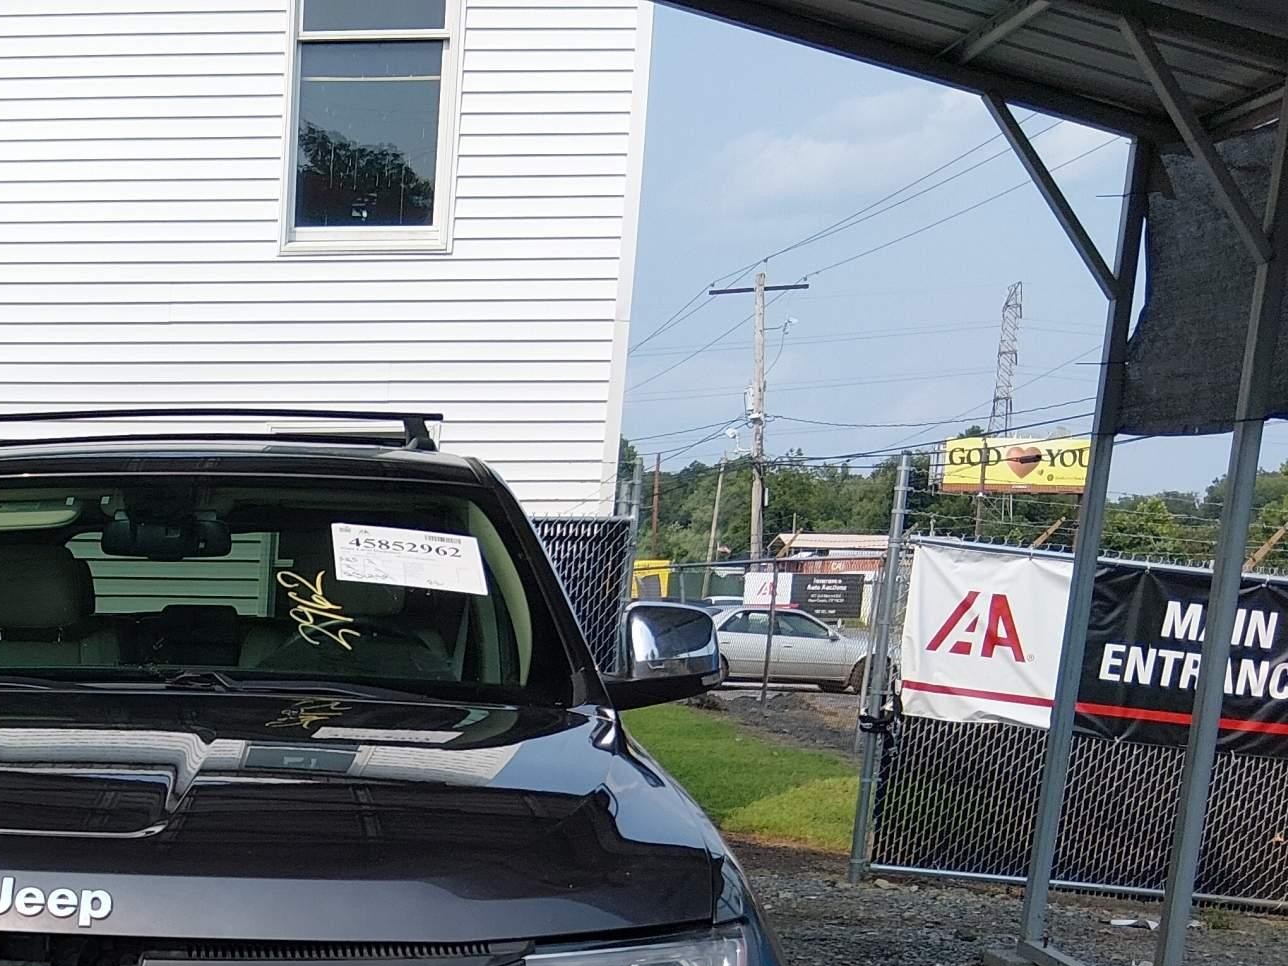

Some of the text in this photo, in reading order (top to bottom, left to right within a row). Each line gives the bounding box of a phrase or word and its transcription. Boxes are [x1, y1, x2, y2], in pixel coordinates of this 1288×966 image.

[949, 447, 1001, 466] GOD
[349, 537, 462, 558] 45852962
[1161, 600, 1279, 649] MIN
